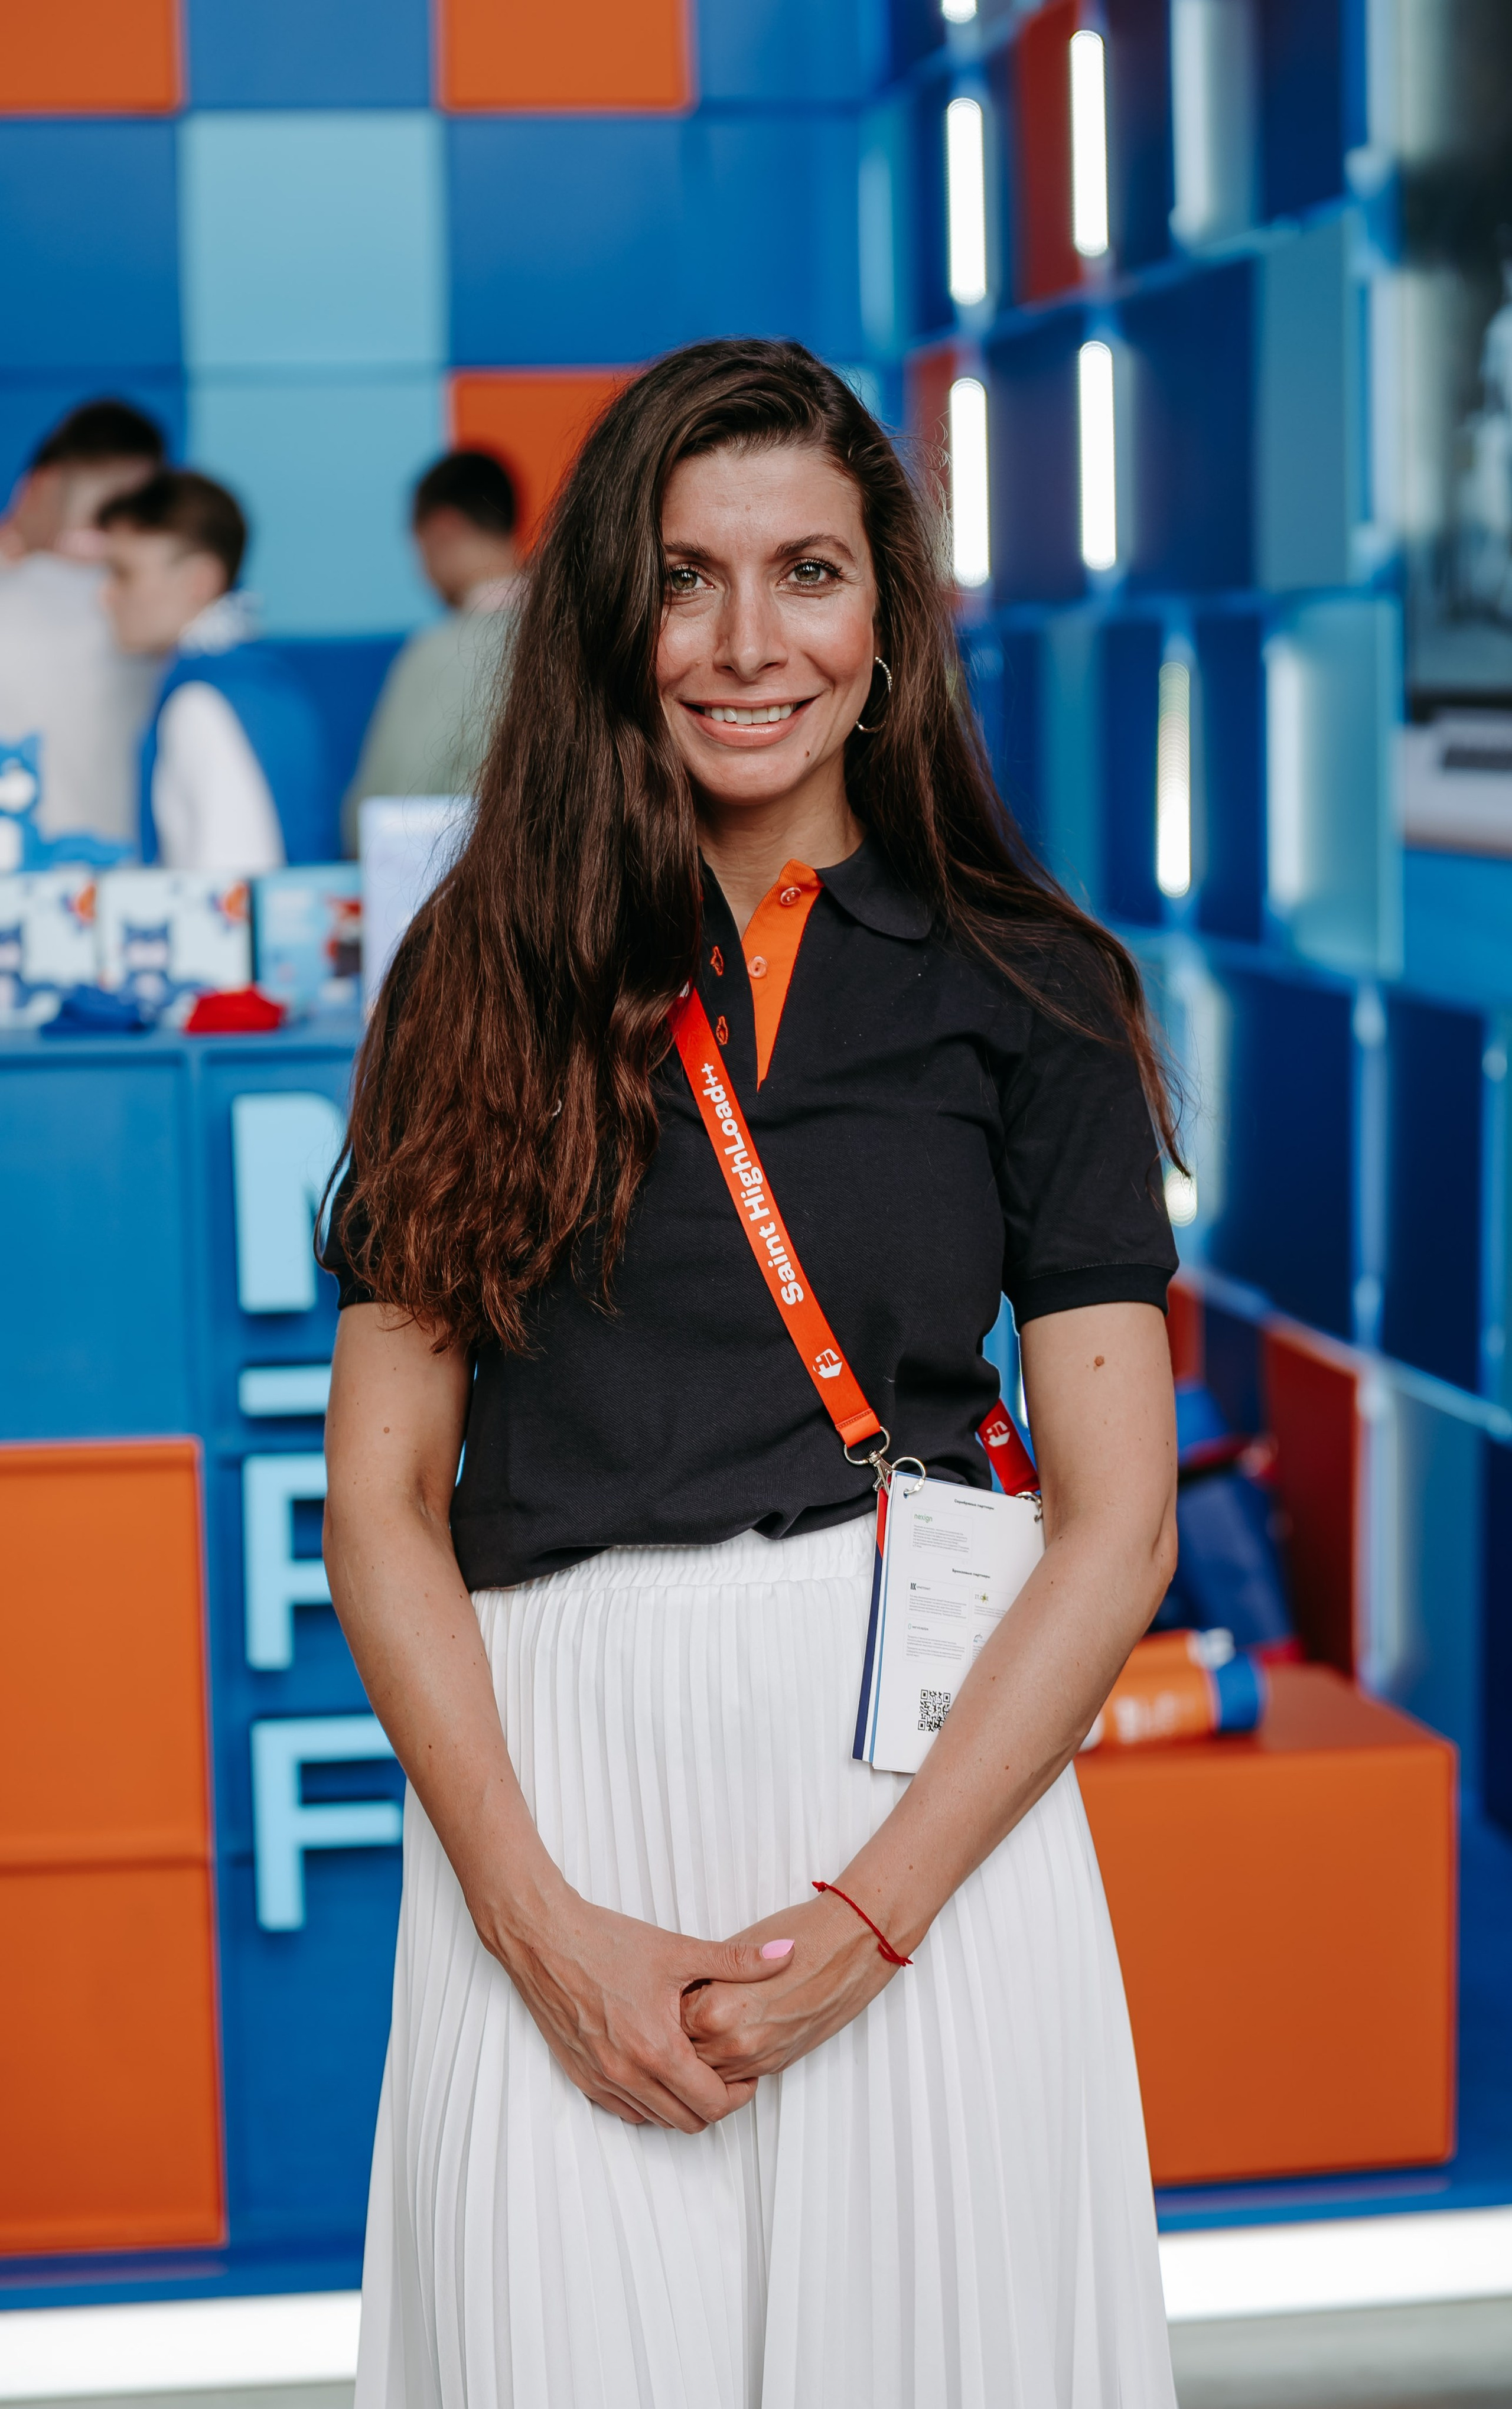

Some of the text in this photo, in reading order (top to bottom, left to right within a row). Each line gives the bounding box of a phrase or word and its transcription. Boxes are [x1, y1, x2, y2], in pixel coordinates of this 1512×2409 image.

[701, 1063, 804, 1306] Saint HighLoad++
[914, 1513, 933, 1523] nexign
